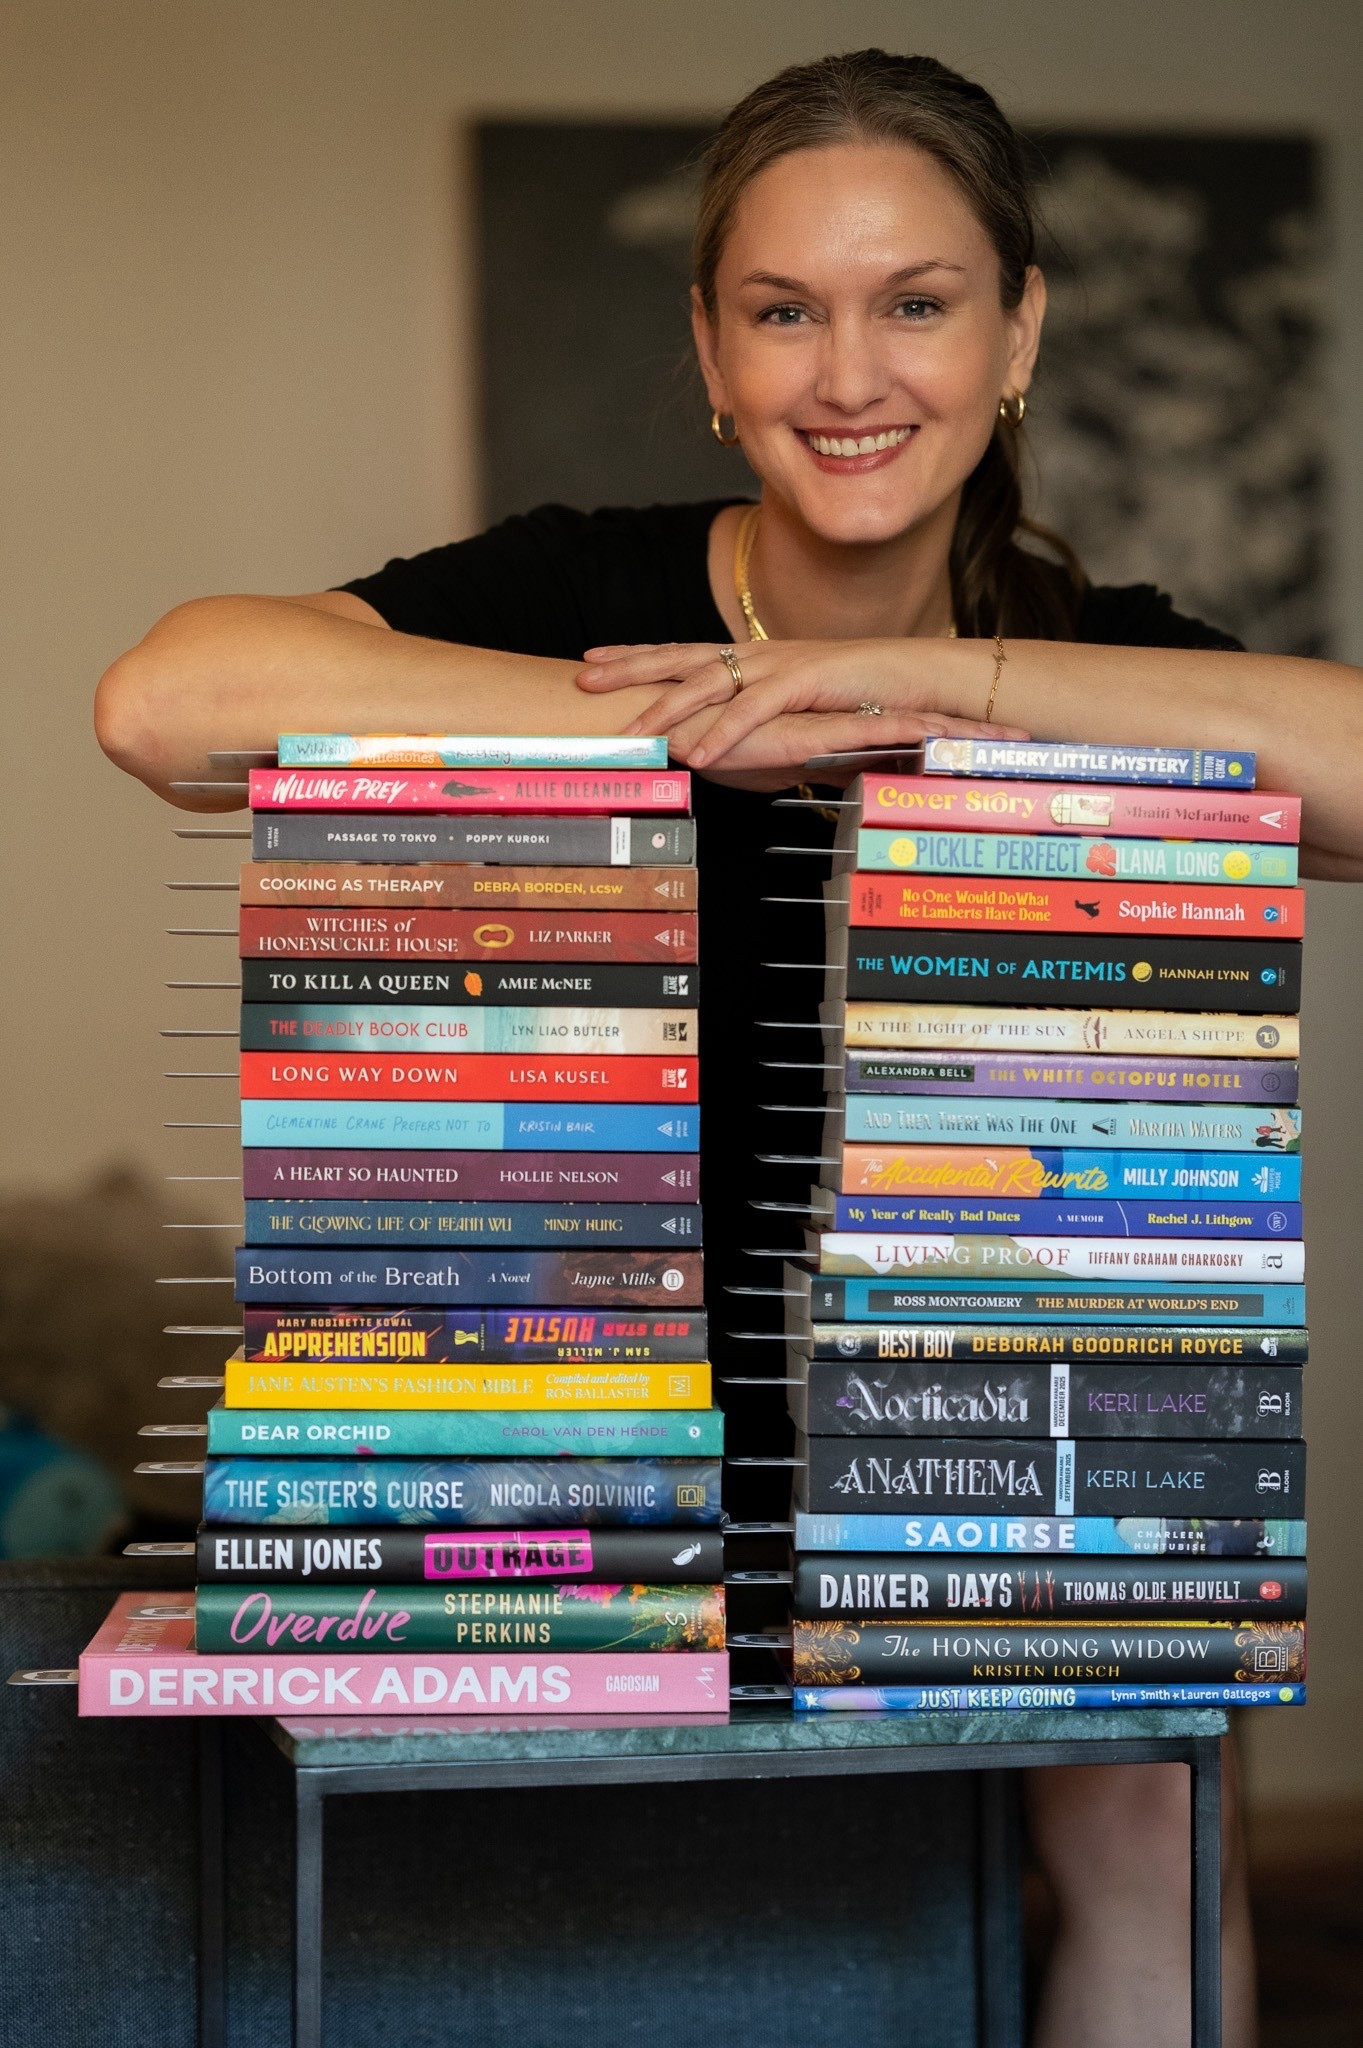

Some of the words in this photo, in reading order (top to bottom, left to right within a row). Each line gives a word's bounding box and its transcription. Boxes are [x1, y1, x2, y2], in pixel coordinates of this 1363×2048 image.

[975, 748, 987, 764] A
[992, 749, 1049, 767] MERRY
[1054, 752, 1107, 770] LITTLE
[1111, 757, 1190, 774] MYSTERY
[1204, 756, 1214, 780] SUTTON
[1215, 758, 1226, 779] CLARK
[272, 774, 348, 803] WILLING
[352, 778, 408, 804] PREY
[516, 782, 556, 798] ALLIE
[564, 783, 642, 798] OLEANDER
[877, 786, 958, 810] Cover
[965, 790, 1038, 818] Story
[327, 833, 378, 842] PASSAGE
[382, 834, 396, 842] TO
[400, 834, 437, 843] TOKYO
[466, 834, 503, 843] POPPY
[507, 835, 550, 844] KUROKI
[916, 836, 985, 867] PICKLE
[996, 840, 1081, 873] PERFECT
[260, 878, 337, 891] COOKING
[341, 879, 363, 891] AS
[367, 879, 445, 892] THERAPY
[473, 882, 521, 893] DEBRA
[524, 882, 586, 895] BORDEN,
[590, 884, 623, 894] LCSW
[1119, 900, 1177, 922] Sophie
[1182, 902, 1245, 921] Hannah
[306, 918, 388, 933] WITCHES
[394, 917, 416, 933] of
[259, 937, 390, 952] HONEYSUCKLE
[396, 938, 459, 952] HOUSE
[529, 930, 551, 943] LIZ
[556, 930, 612, 943] PARKER
[856, 957, 884, 971] THE
[890, 956, 990, 977] WOMEN
[996, 962, 1016, 975] OF
[1021, 960, 1126, 982] ARTEMIS
[1159, 968, 1214, 980] HANNAH
[1218, 970, 1249, 980] LYNN
[269, 974, 297, 990] TO
[304, 974, 354, 990] KILL
[358, 975, 373, 990] A
[378, 975, 450, 994] QUEEN
[498, 978, 538, 990] AMIE
[541, 978, 592, 991] McNEE
[669, 975, 678, 994] LANE
[512, 1025, 534, 1036] LYN
[539, 1026, 569, 1036] LIAO
[574, 1026, 620, 1037] BUTLER
[271, 1066, 330, 1082] LONG
[338, 1067, 383, 1082] WAY
[392, 1068, 457, 1083] DOWN
[510, 1070, 547, 1083] LISA
[554, 1070, 610, 1084] KUSEL
[667, 1069, 676, 1088] LANE
[867, 1066, 935, 1077] ALEXANDRA
[939, 1068, 967, 1078] BELL
[273, 1167, 285, 1180] A
[290, 1167, 343, 1181] HEART
[348, 1167, 371, 1181] SO
[376, 1167, 459, 1182] HAUNTED
[500, 1171, 553, 1182] HOLLIE
[559, 1172, 619, 1183] NELSON
[1123, 1168, 1168, 1186] MILLY
[1171, 1169, 1239, 1187] JOHNSON
[1056, 1214, 1063, 1222] A
[1067, 1215, 1104, 1223] MEMOIR
[1147, 1213, 1187, 1224] Rachel
[1191, 1214, 1202, 1225] J.
[1205, 1214, 1253, 1228] Lithgow
[1088, 1251, 1130, 1265] TIFFANY
[1133, 1252, 1178, 1266] GRAHAM
[1181, 1252, 1244, 1267] CHARKOSKY
[249, 1266, 332, 1284] Bottom
[339, 1271, 354, 1283] of
[357, 1271, 377, 1283] the
[385, 1266, 460, 1285] Breath
[488, 1273, 496, 1282] A
[500, 1272, 531, 1283] Novel
[893, 1295, 926, 1307] ROSS
[928, 1296, 1023, 1308] MONTGOMERY
[1036, 1298, 1064, 1309] THE
[1066, 1298, 1124, 1309] MURDER
[1127, 1299, 1145, 1309] AT
[1147, 1299, 1208, 1310] WORLD'S
[1211, 1300, 1239, 1310] END
[277, 1319, 306, 1327] MARY
[311, 1318, 372, 1327] ROBINETTE
[376, 1318, 412, 1327] KOWAL
[264, 1331, 427, 1357] APPREHENSION
[558, 1347, 602, 1357] MILLER
[626, 1347, 650, 1356] SAM
[878, 1330, 919, 1358] BEST
[923, 1330, 956, 1358] BOY
[972, 1336, 1064, 1353] DEBORAH
[1072, 1337, 1173, 1354] GOODRICH
[1181, 1338, 1243, 1354] ROYCE
[1088, 1393, 1138, 1412] KERI
[1148, 1394, 1207, 1413] LAKE
[241, 1425, 299, 1440] DEAR
[306, 1425, 391, 1440] ORCHID
[829, 1458, 1043, 1495] ANATHEMA
[1087, 1470, 1136, 1488] KERI
[1146, 1471, 1205, 1489] LAKE
[225, 1480, 268, 1508] THE
[277, 1481, 378, 1509] SISTER'S
[387, 1481, 464, 1509] CURSE
[490, 1484, 561, 1506] NICOLA
[568, 1484, 655, 1507] SOLVINIC
[905, 1521, 1075, 1549] SAOIRSE
[1137, 1530, 1204, 1539] CHARLEEN
[433, 1538, 585, 1572] OUTRAGE
[1134, 1543, 1206, 1551] HURTUBISE
[215, 1538, 293, 1570] ELLEN
[302, 1538, 383, 1575] JONES
[820, 1574, 929, 1608] DARKER
[947, 1573, 1012, 1608] DAYS
[1064, 1582, 1126, 1600] THOMAS
[1132, 1582, 1167, 1600] OLDE
[1172, 1581, 1240, 1600] HEUVELT
[444, 1593, 563, 1616] STEPHANIE
[230, 1588, 411, 1646] Overdue
[457, 1622, 551, 1643] PERKINS
[882, 1636, 920, 1657] The
[933, 1637, 1011, 1657] HONG
[1024, 1638, 1099, 1658] KONG
[1111, 1639, 1210, 1659] WIDOW
[973, 1665, 1045, 1677] KRISTEN
[1054, 1665, 1120, 1677] LOESCH
[109, 1667, 363, 1706] DERRICK
[371, 1666, 571, 1705] ADAMS
[605, 1675, 660, 1692] GAGOSIAN
[918, 1689, 961, 1708] JUST
[967, 1688, 1012, 1707] KEEP
[1018, 1687, 1076, 1707] GOING
